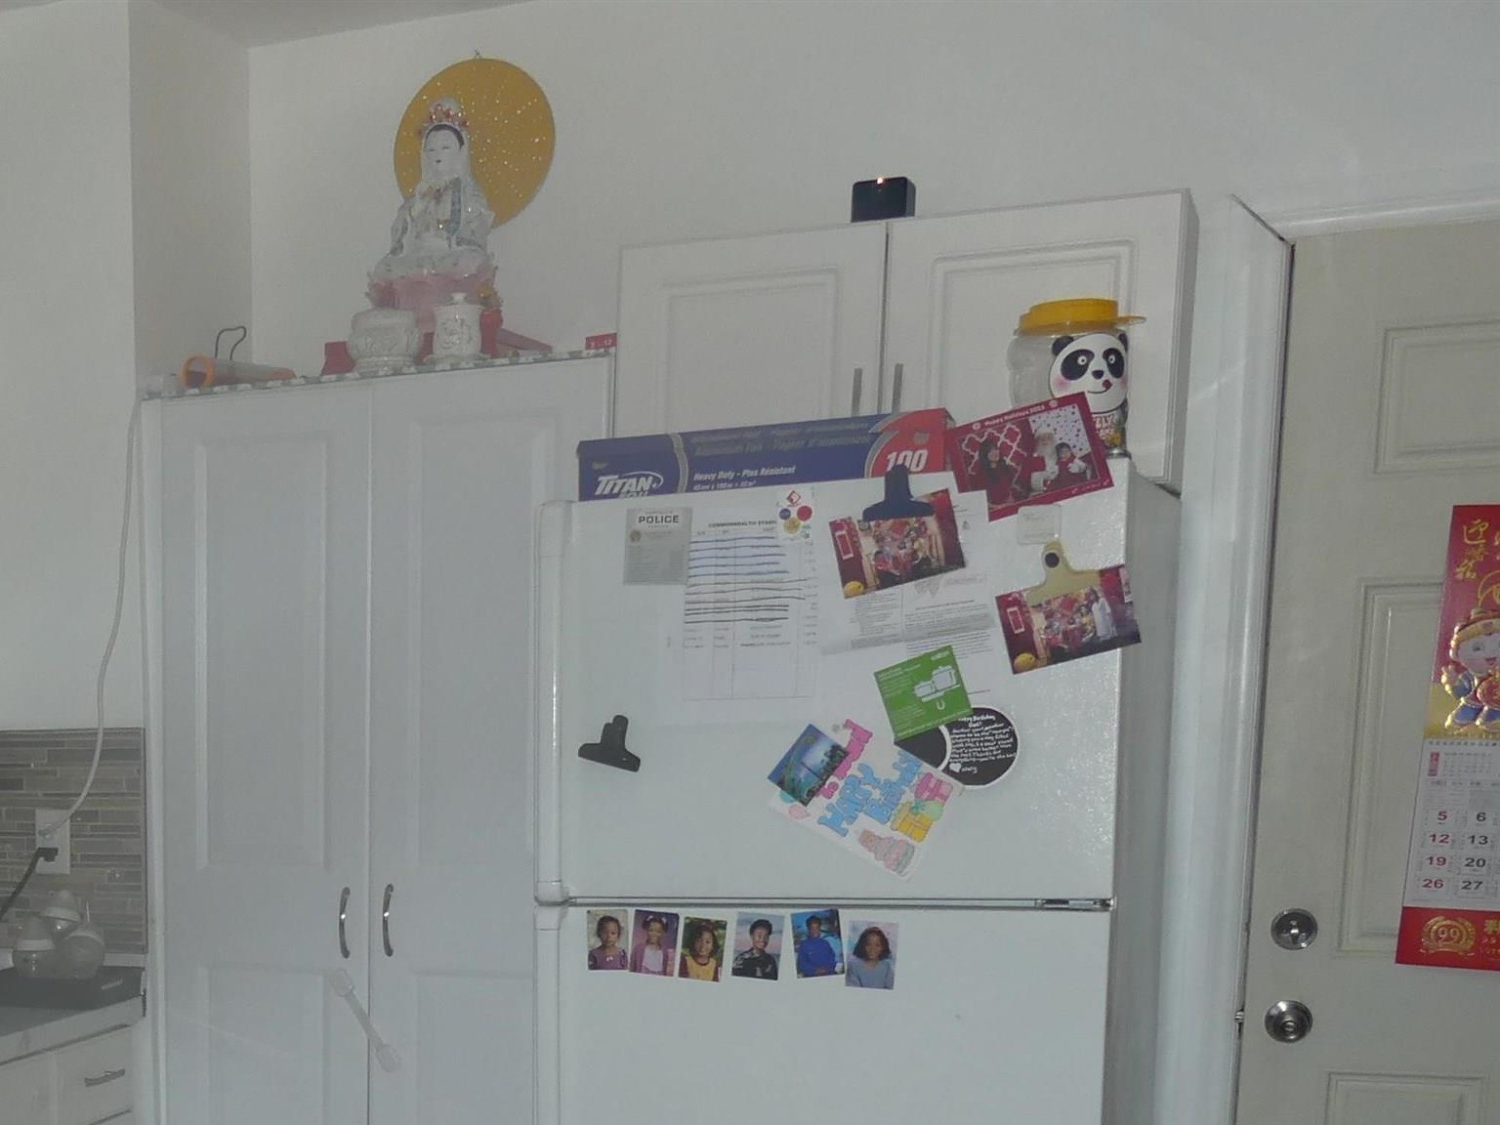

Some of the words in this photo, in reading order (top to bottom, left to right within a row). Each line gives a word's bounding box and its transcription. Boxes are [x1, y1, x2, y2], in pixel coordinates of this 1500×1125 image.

[638, 515, 680, 524] POLICE
[1437, 810, 1449, 822] 5
[1475, 811, 1487, 823] 6
[1429, 833, 1450, 845] 12
[1467, 834, 1489, 846] 13
[1426, 856, 1447, 867] 19
[1464, 857, 1487, 869] 20
[1421, 878, 1445, 889] 26
[1461, 880, 1484, 891] 27
